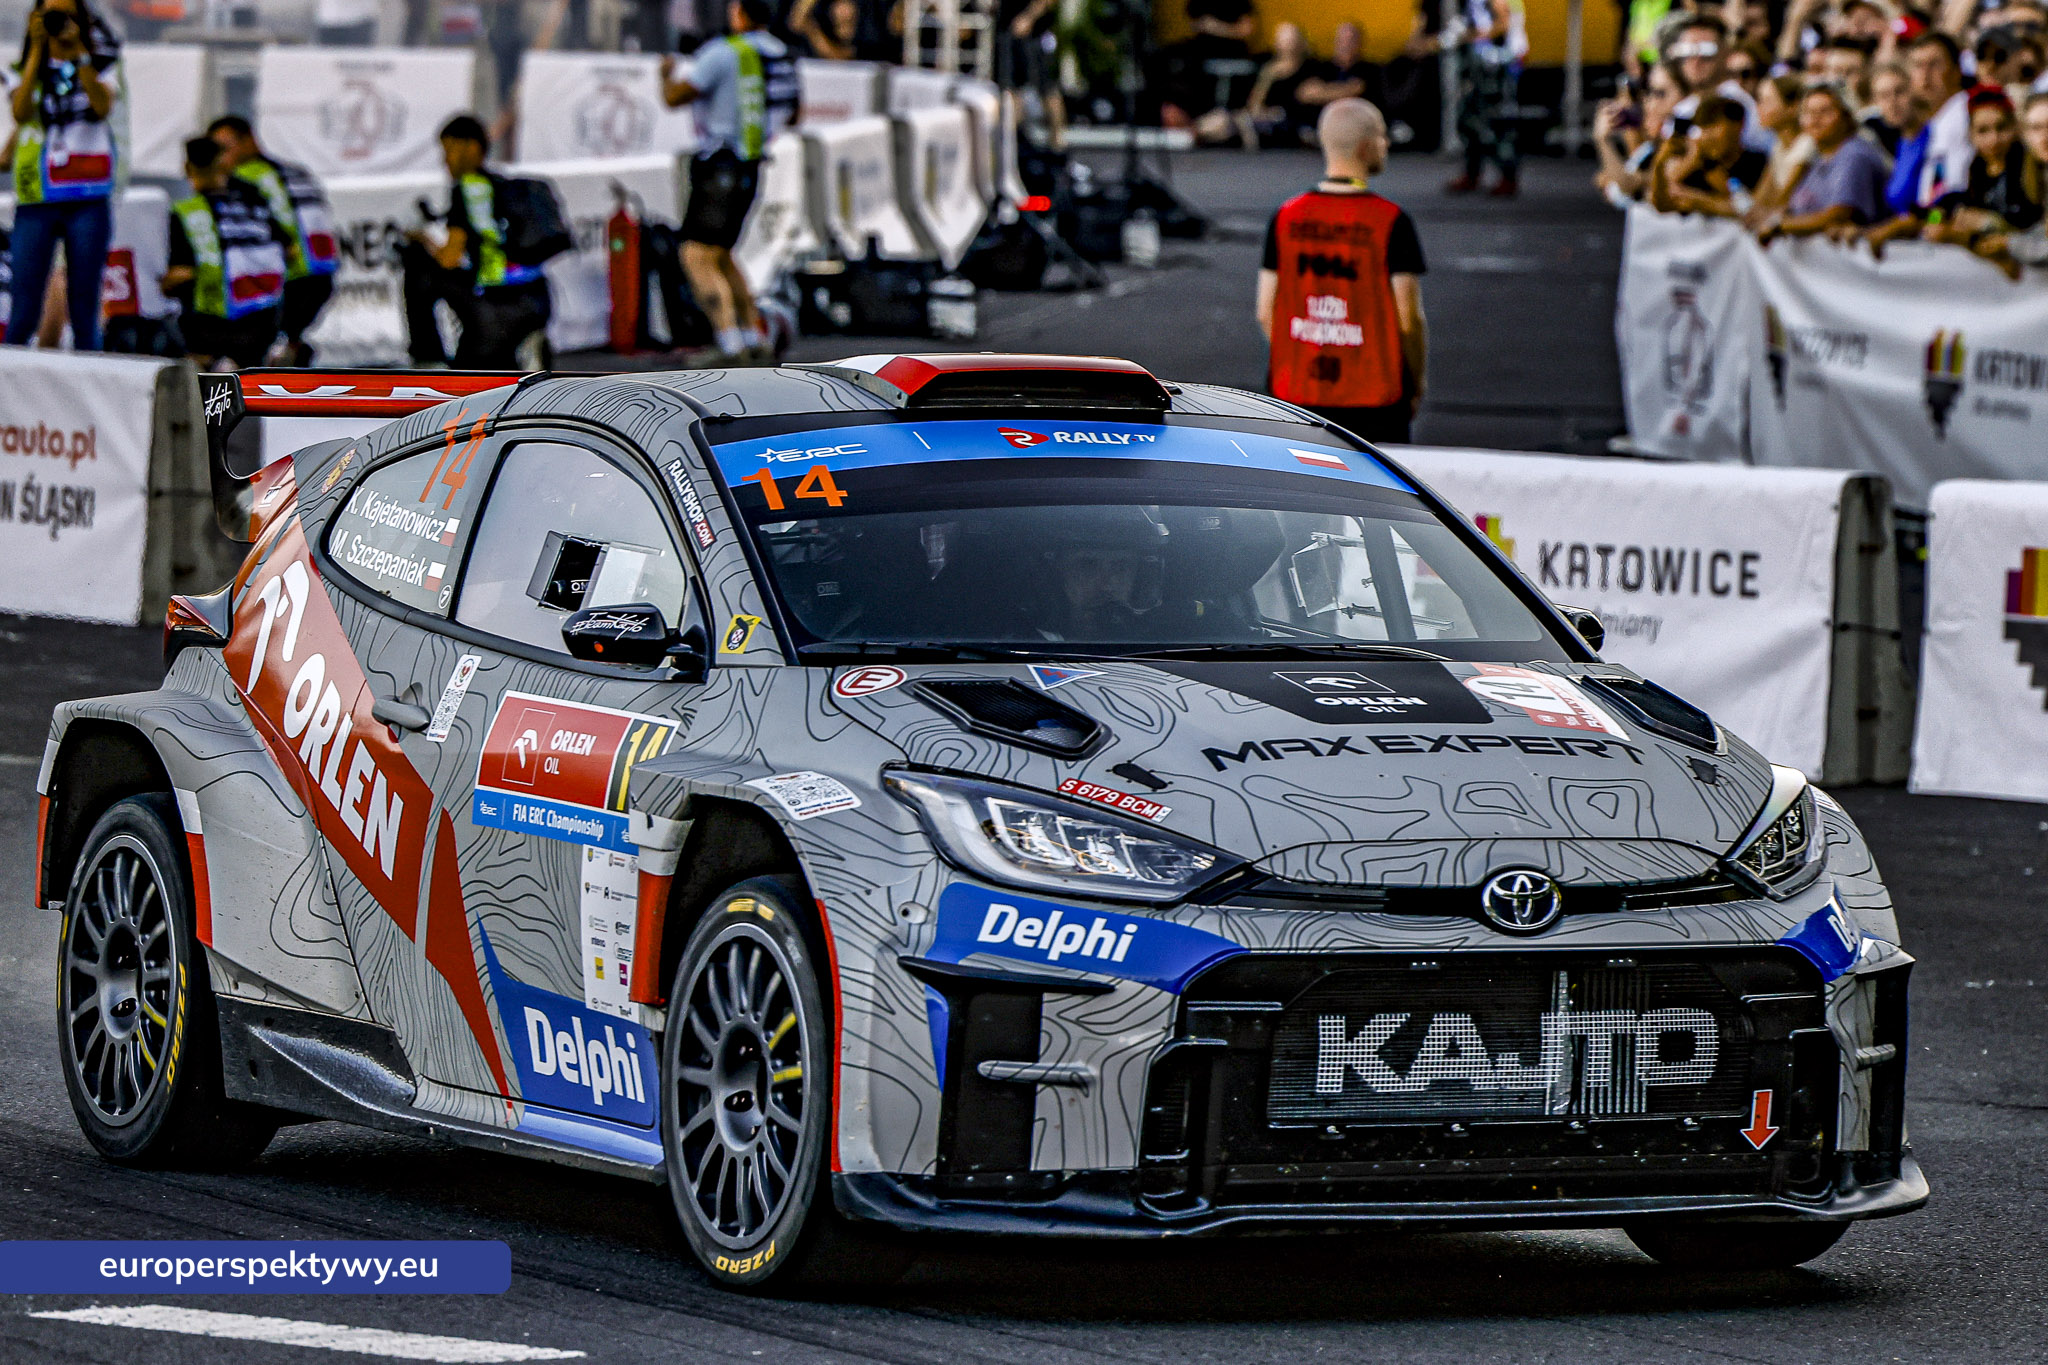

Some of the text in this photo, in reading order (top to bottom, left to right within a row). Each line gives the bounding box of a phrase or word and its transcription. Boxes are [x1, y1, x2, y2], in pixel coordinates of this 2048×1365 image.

[419, 407, 488, 511] 14
[741, 465, 849, 511] 14
[20, 471, 96, 541] ŚLĄSKI
[345, 485, 446, 543] K. Kajetanowicz
[667, 459, 714, 547] RALLYSHOP.COM
[328, 528, 427, 587] M. Szczepaniak
[1539, 539, 1760, 599] KATOWICE
[848, 671, 892, 688] E
[1315, 697, 1428, 706] ORLEN
[283, 653, 404, 881] ORLEN
[544, 757, 560, 775] OIL
[550, 729, 597, 756] ORLEN
[1201, 735, 1644, 772] MAX EXPERT
[512, 804, 528, 822] FIA
[528, 807, 545, 827] ERC
[546, 810, 604, 841] Championship
[1061, 780, 1160, 817] S 6179 BCM
[977, 903, 1138, 962] Delphi
[524, 1006, 645, 1106] Delphi
